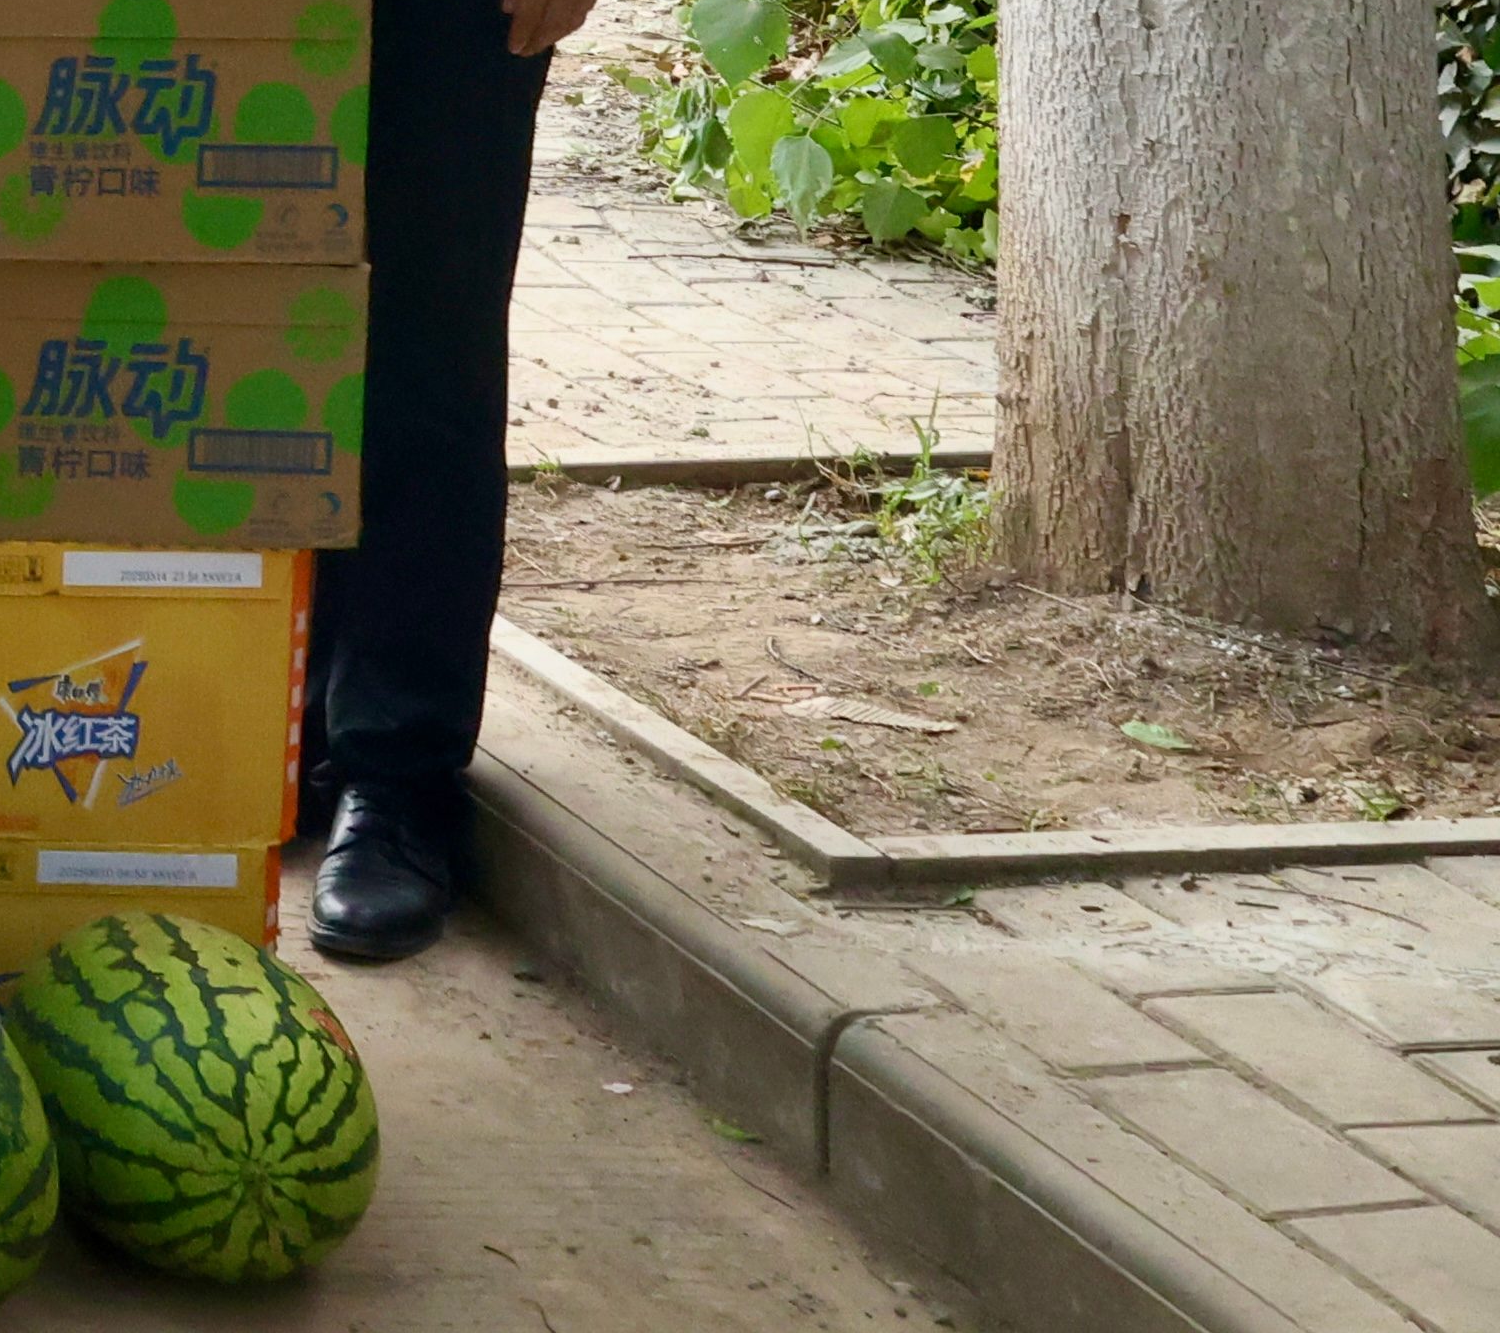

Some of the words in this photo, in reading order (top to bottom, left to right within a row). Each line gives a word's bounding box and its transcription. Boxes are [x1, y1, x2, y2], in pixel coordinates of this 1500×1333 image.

[33, 53, 217, 157] 脉动
[30, 165, 160, 197] 青柠口味
[21, 337, 209, 438] 脉动
[18, 445, 150, 479] 青柠口味
[10, 711, 137, 774] 冰红茶
